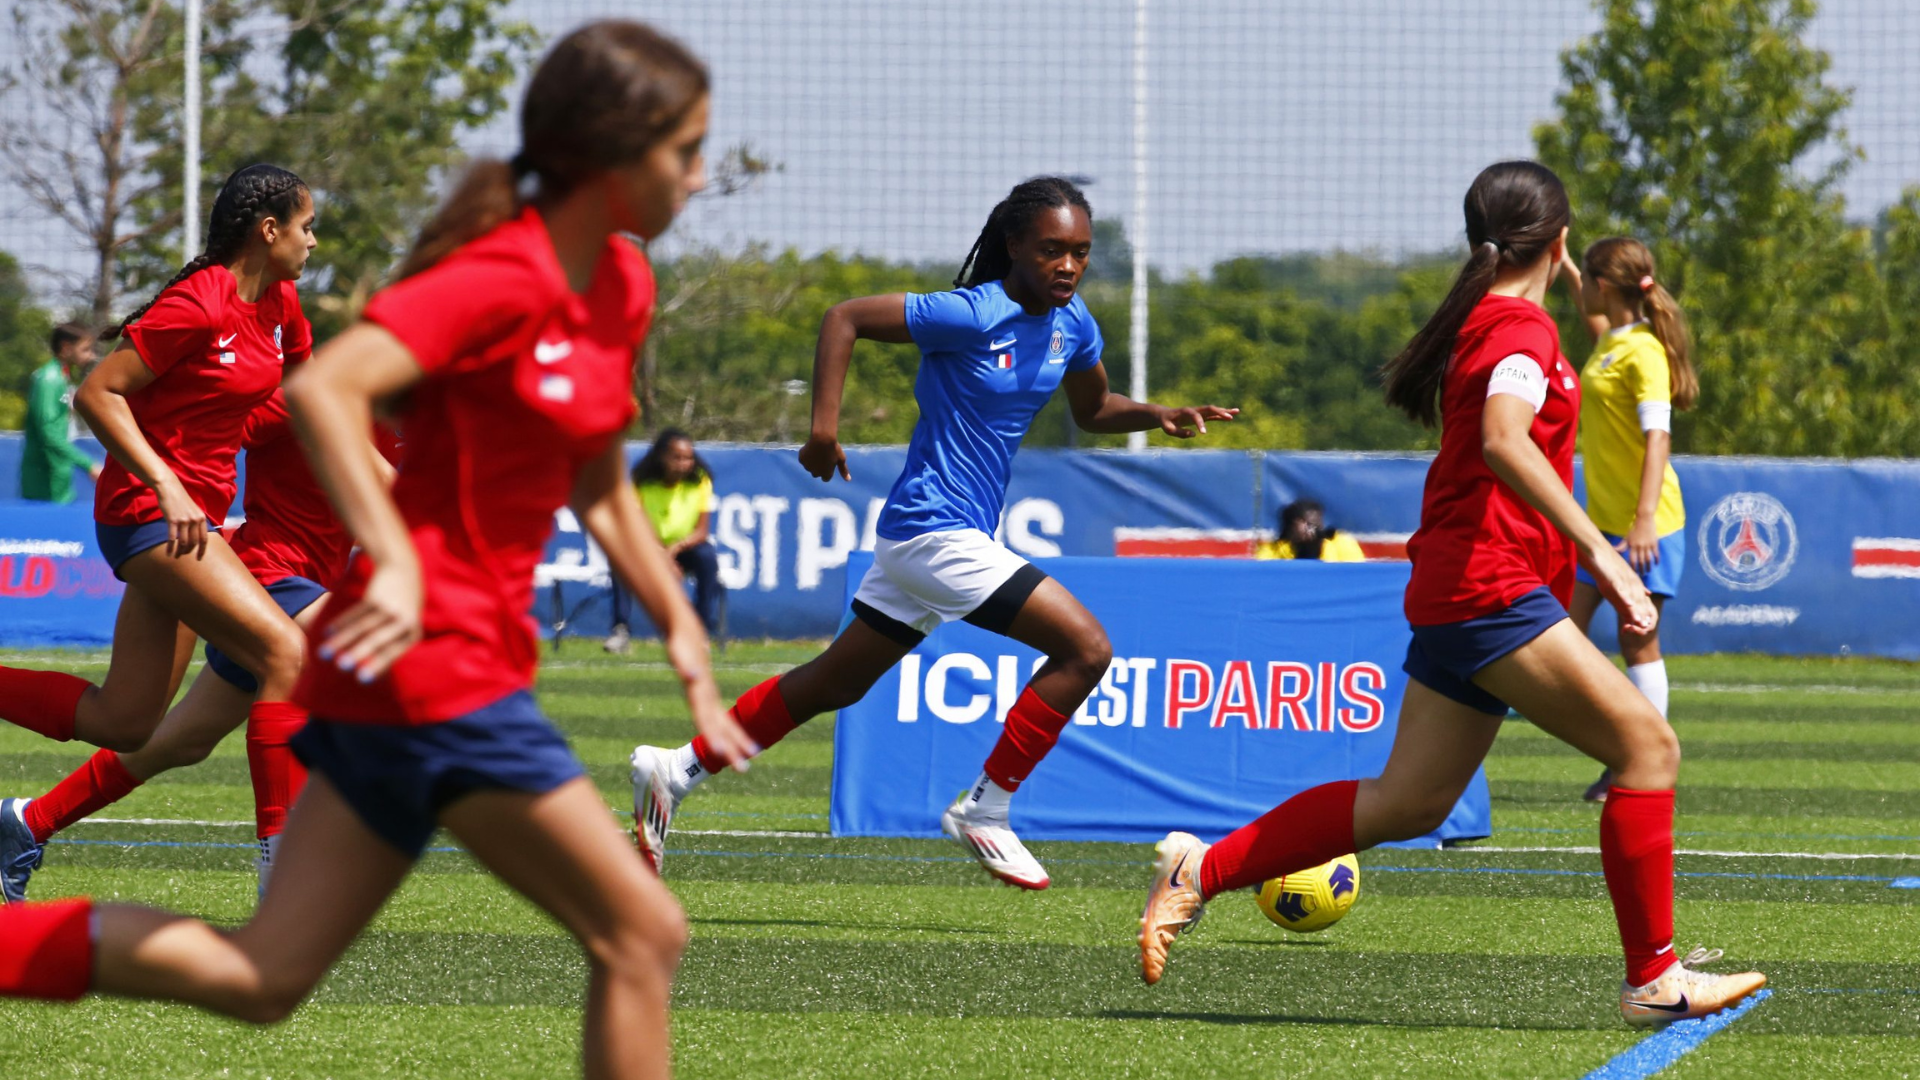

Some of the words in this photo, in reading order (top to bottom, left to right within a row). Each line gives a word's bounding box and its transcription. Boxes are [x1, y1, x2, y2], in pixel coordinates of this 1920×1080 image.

[1491, 367, 1529, 382] APTAIN
[897, 652, 1018, 724] ICI
[1032, 655, 1156, 728] EST
[1164, 658, 1386, 733] PARIS
